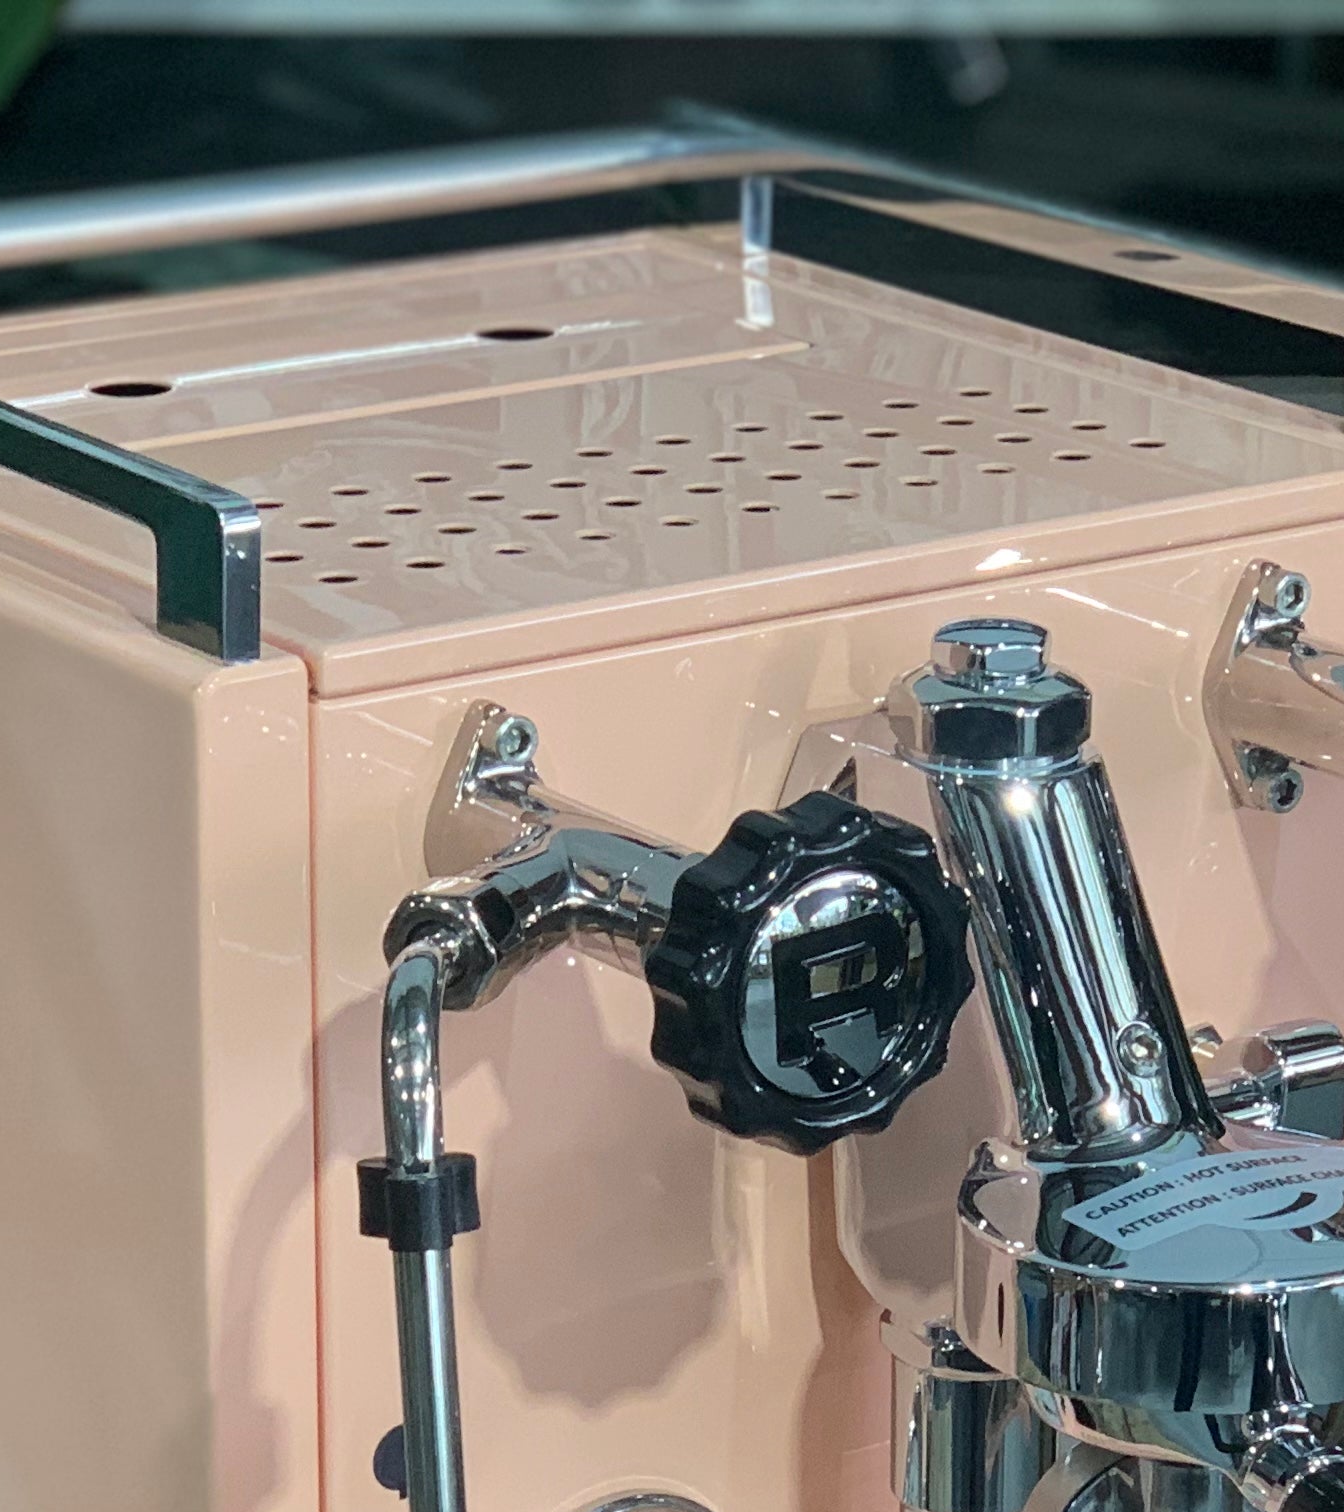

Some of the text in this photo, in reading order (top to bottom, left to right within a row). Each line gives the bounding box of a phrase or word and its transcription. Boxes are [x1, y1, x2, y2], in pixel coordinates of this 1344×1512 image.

[771, 912, 910, 1067] R
[1085, 1180, 1175, 1220] CAUTION
[1183, 1165, 1224, 1183] HOT
[1225, 1154, 1307, 1172] SURFACE
[1117, 1193, 1222, 1238] ATTENTION
[1230, 1173, 1313, 1197] SURFACE
